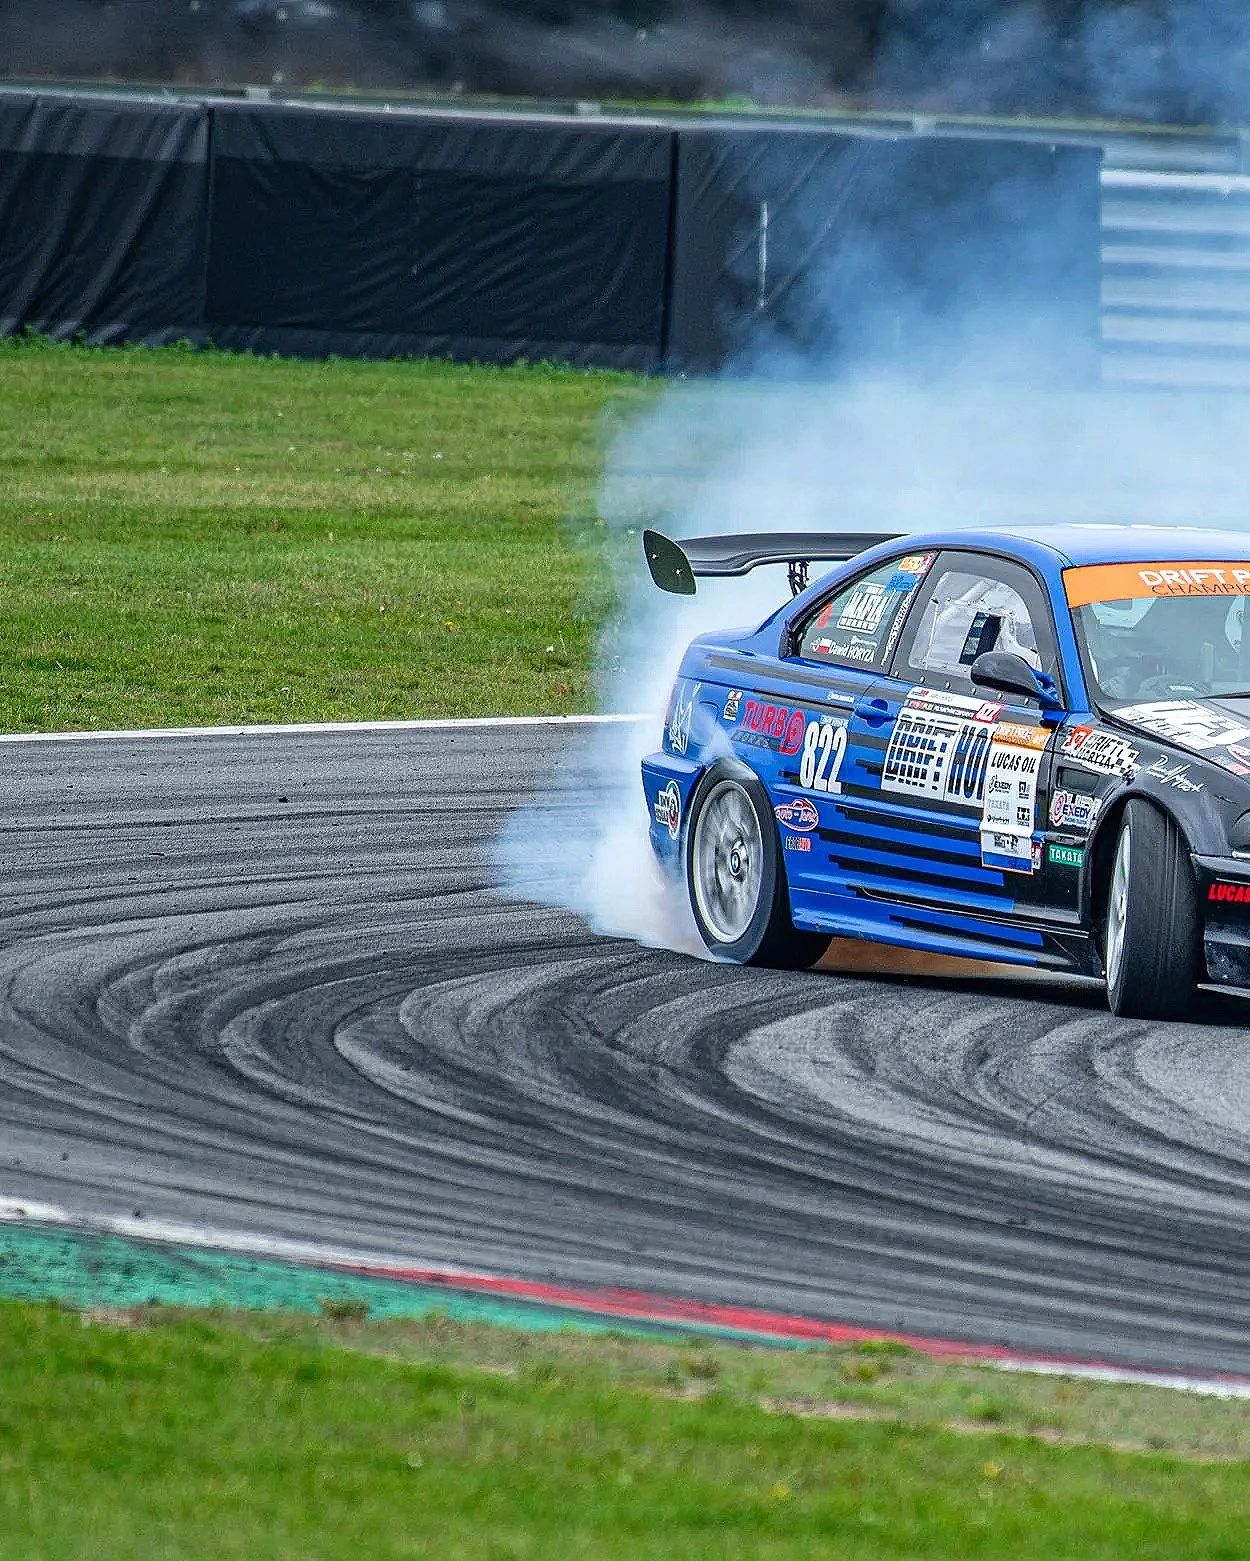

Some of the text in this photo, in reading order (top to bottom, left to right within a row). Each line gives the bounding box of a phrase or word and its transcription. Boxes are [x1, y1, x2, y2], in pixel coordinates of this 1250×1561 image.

[1138, 569, 1225, 587] DRIFT
[800, 721, 847, 794] 822
[991, 751, 1037, 774] LUCAS OIL
[1062, 804, 1091, 818] EXEDY
[1051, 848, 1082, 862] TAKATA
